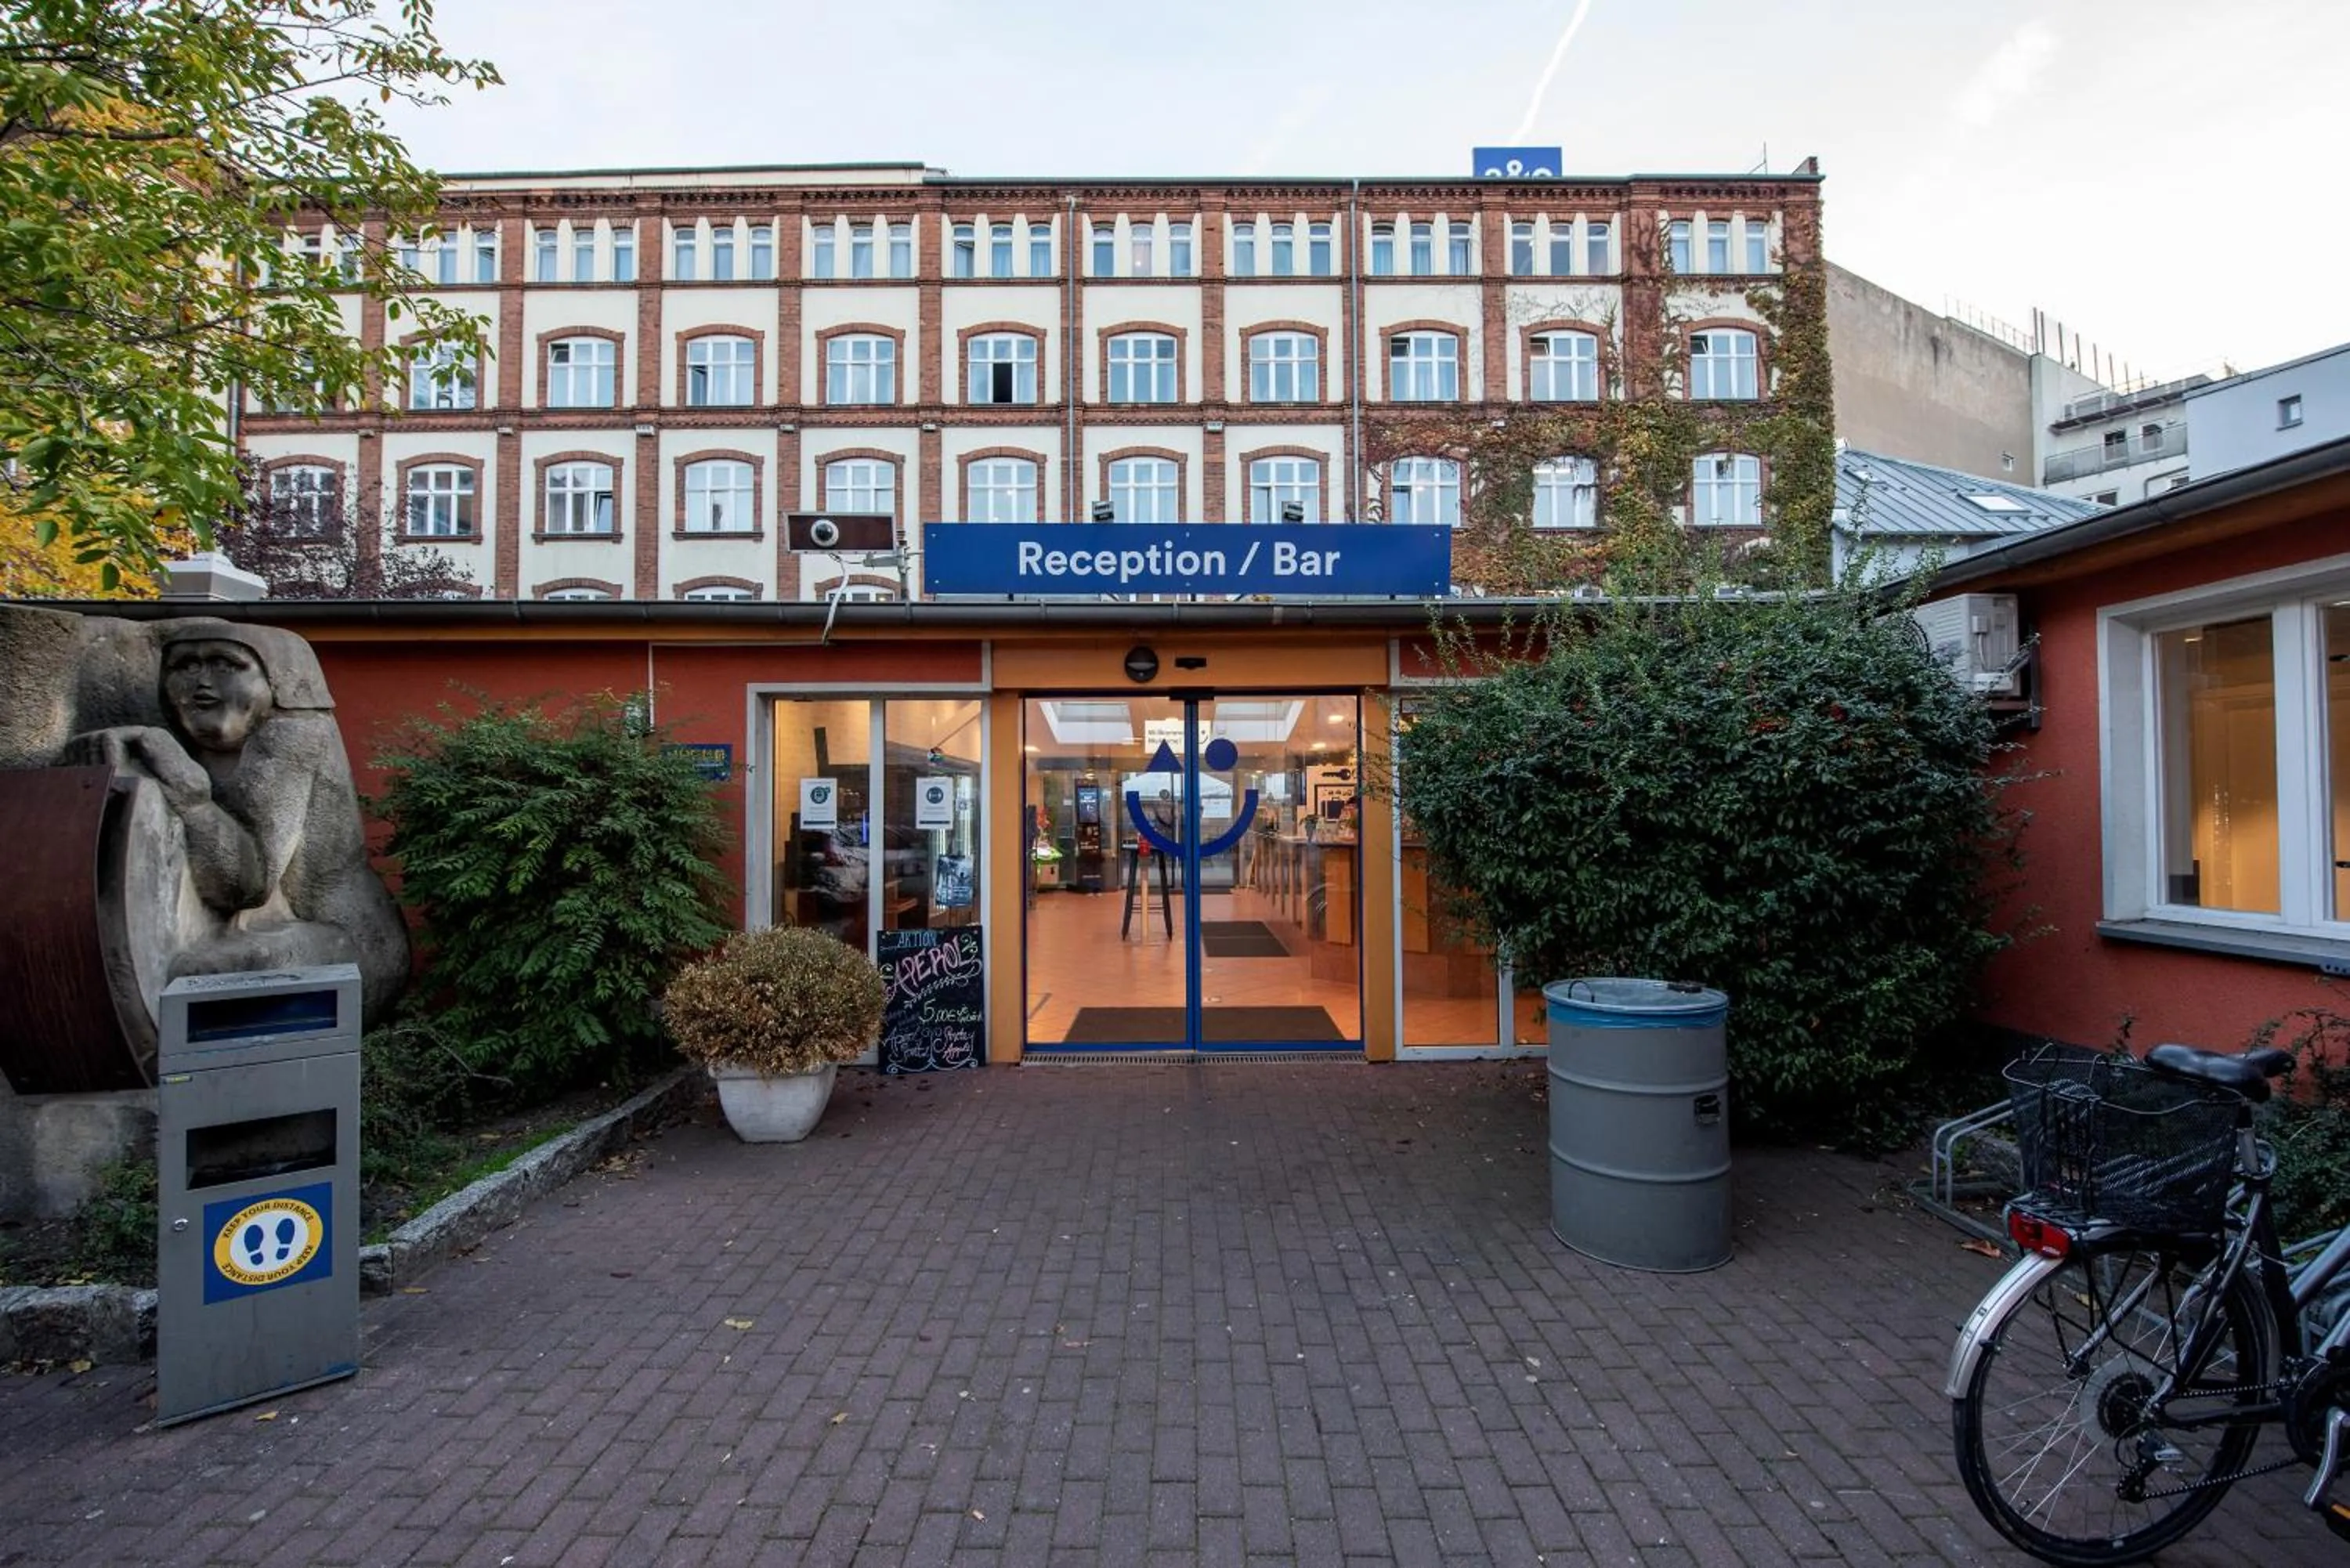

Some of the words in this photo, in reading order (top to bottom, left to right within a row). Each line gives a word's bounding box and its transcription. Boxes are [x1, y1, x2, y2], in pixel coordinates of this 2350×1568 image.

[1019, 540, 1225, 583] Reception
[1238, 541, 1260, 576] /
[1273, 542, 1340, 576] Bar
[898, 930, 937, 948] AKTION
[888, 935, 976, 997] APEROL
[240, 1202, 270, 1219] YOUR
[267, 1265, 295, 1281] YOUR
